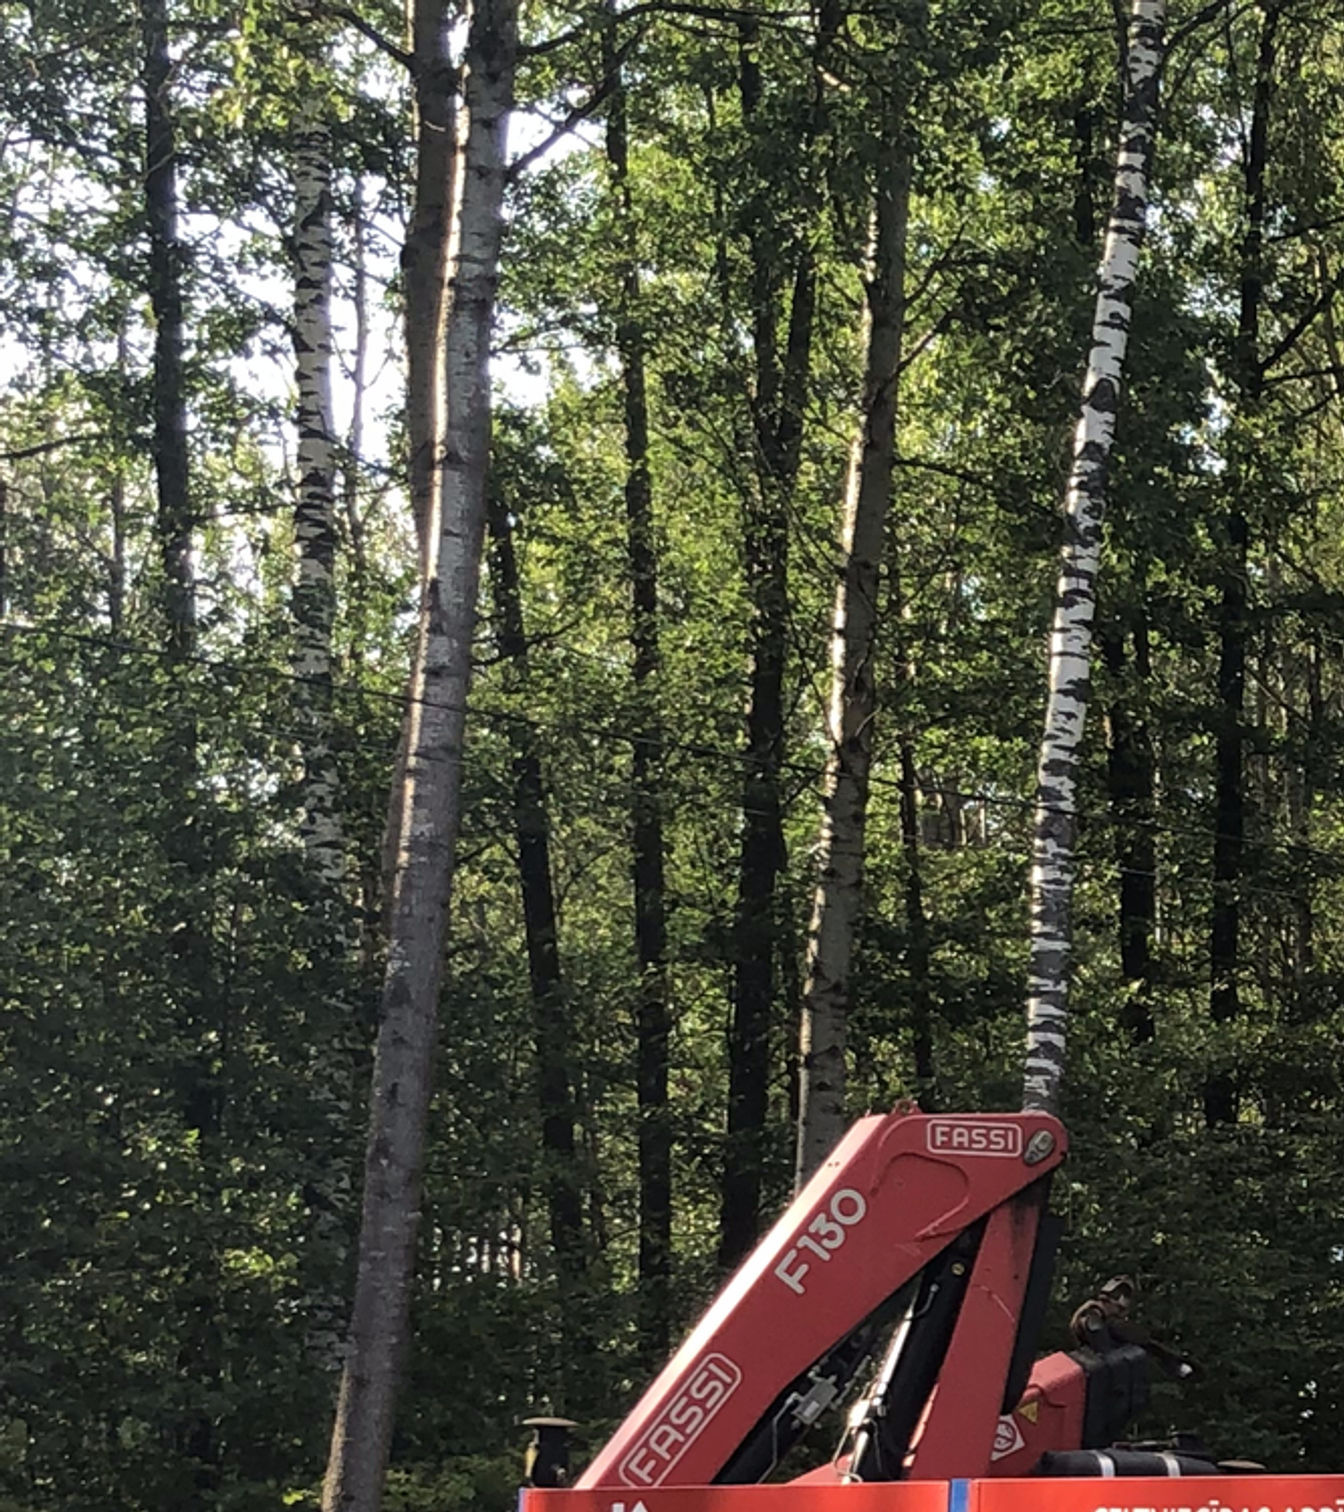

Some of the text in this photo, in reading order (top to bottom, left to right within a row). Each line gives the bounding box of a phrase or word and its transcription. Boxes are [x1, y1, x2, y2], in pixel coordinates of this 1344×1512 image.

[935, 1126, 1014, 1150] FASSI
[774, 1188, 867, 1294] F130
[628, 1362, 732, 1484] FASSI
